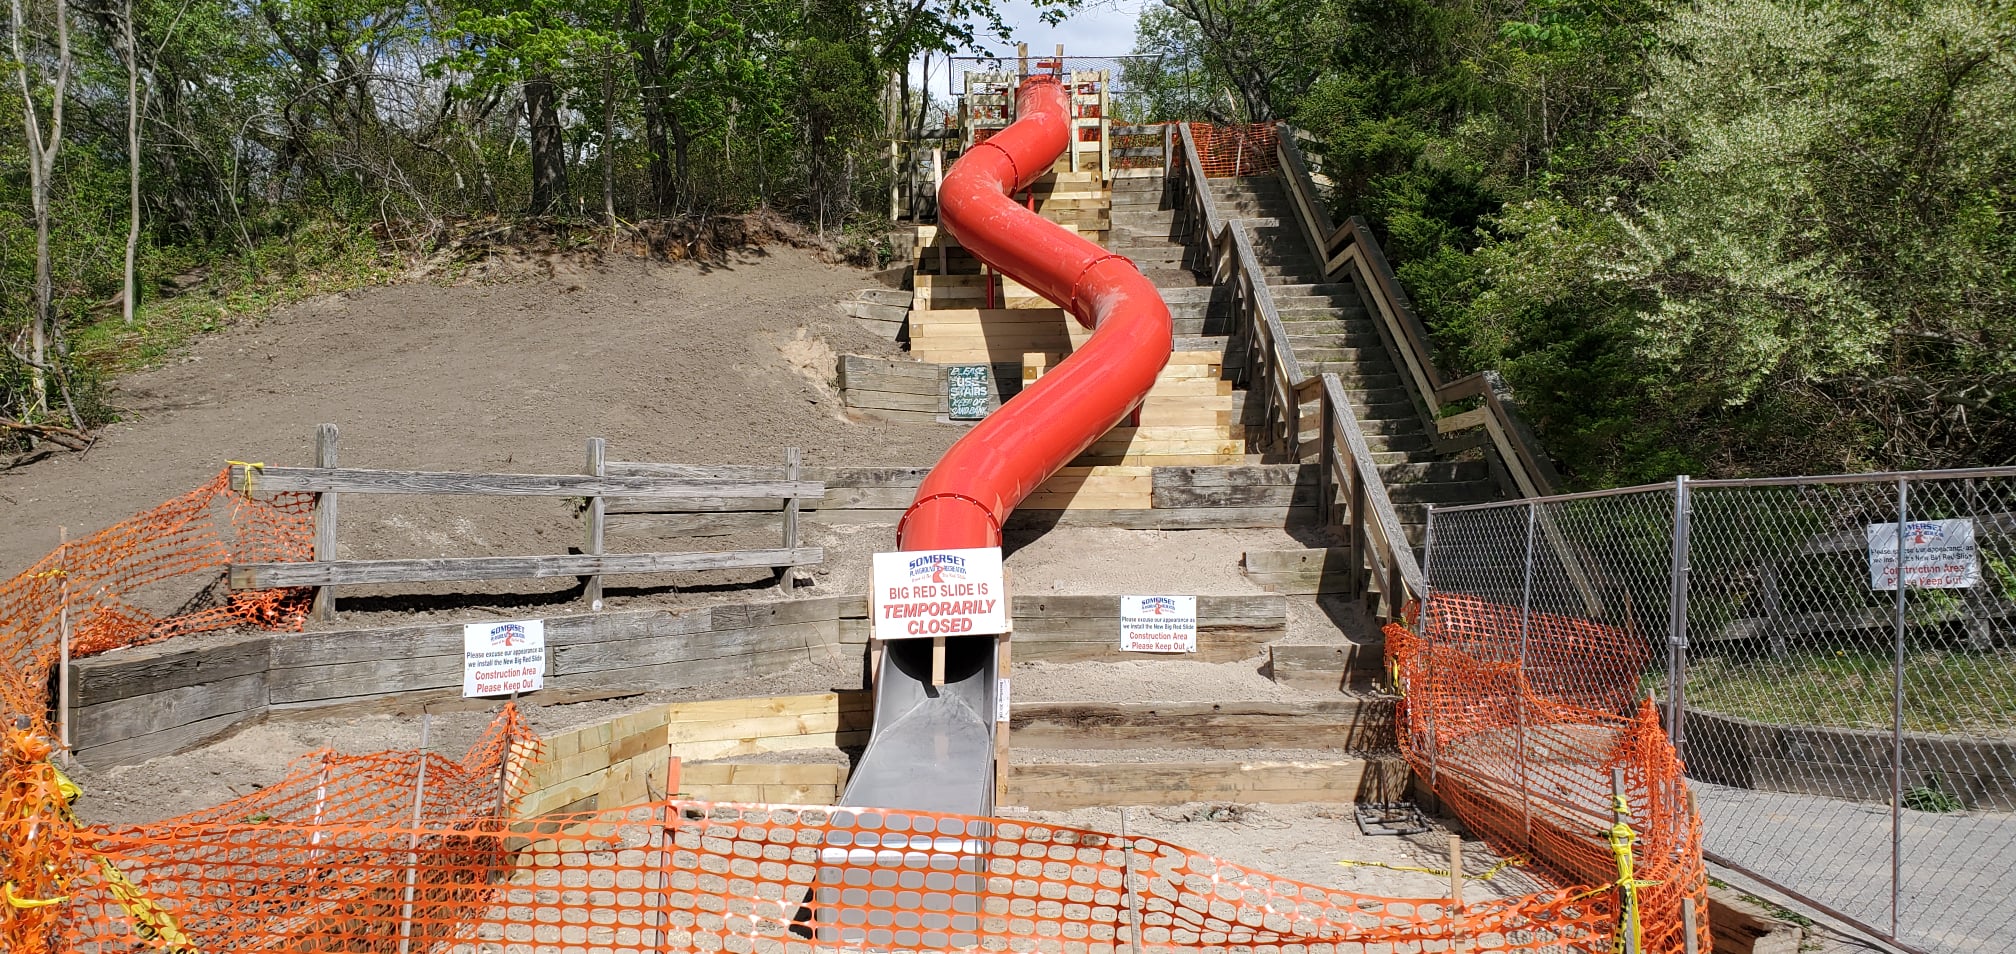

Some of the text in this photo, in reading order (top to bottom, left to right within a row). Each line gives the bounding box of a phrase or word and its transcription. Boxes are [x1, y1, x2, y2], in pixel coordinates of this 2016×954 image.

[950, 367, 985, 376] PLEASE
[957, 377, 979, 386] USE
[950, 387, 987, 397] STAIRS
[1905, 523, 1942, 532] MERSET
[909, 554, 966, 570] SOMERSET
[1883, 563, 1965, 575] Contruction Area
[1920, 577, 1943, 586] Keep
[1946, 576, 1963, 584] Out
[889, 582, 989, 600] BIG RED SLIDE IS
[1141, 597, 1175, 606] SOMERSET
[883, 599, 996, 619] TEMPORARILY
[490, 624, 525, 636] SOMERSET
[907, 617, 973, 635] CLOSED
[1129, 632, 1188, 640] Construction Area
[1132, 641, 1185, 651] Please Keep Out
[513, 647, 537, 656] appearance
[477, 659, 493, 667] install
[475, 666, 537, 680] Construction Area
[477, 679, 533, 693] Please Keep Out
